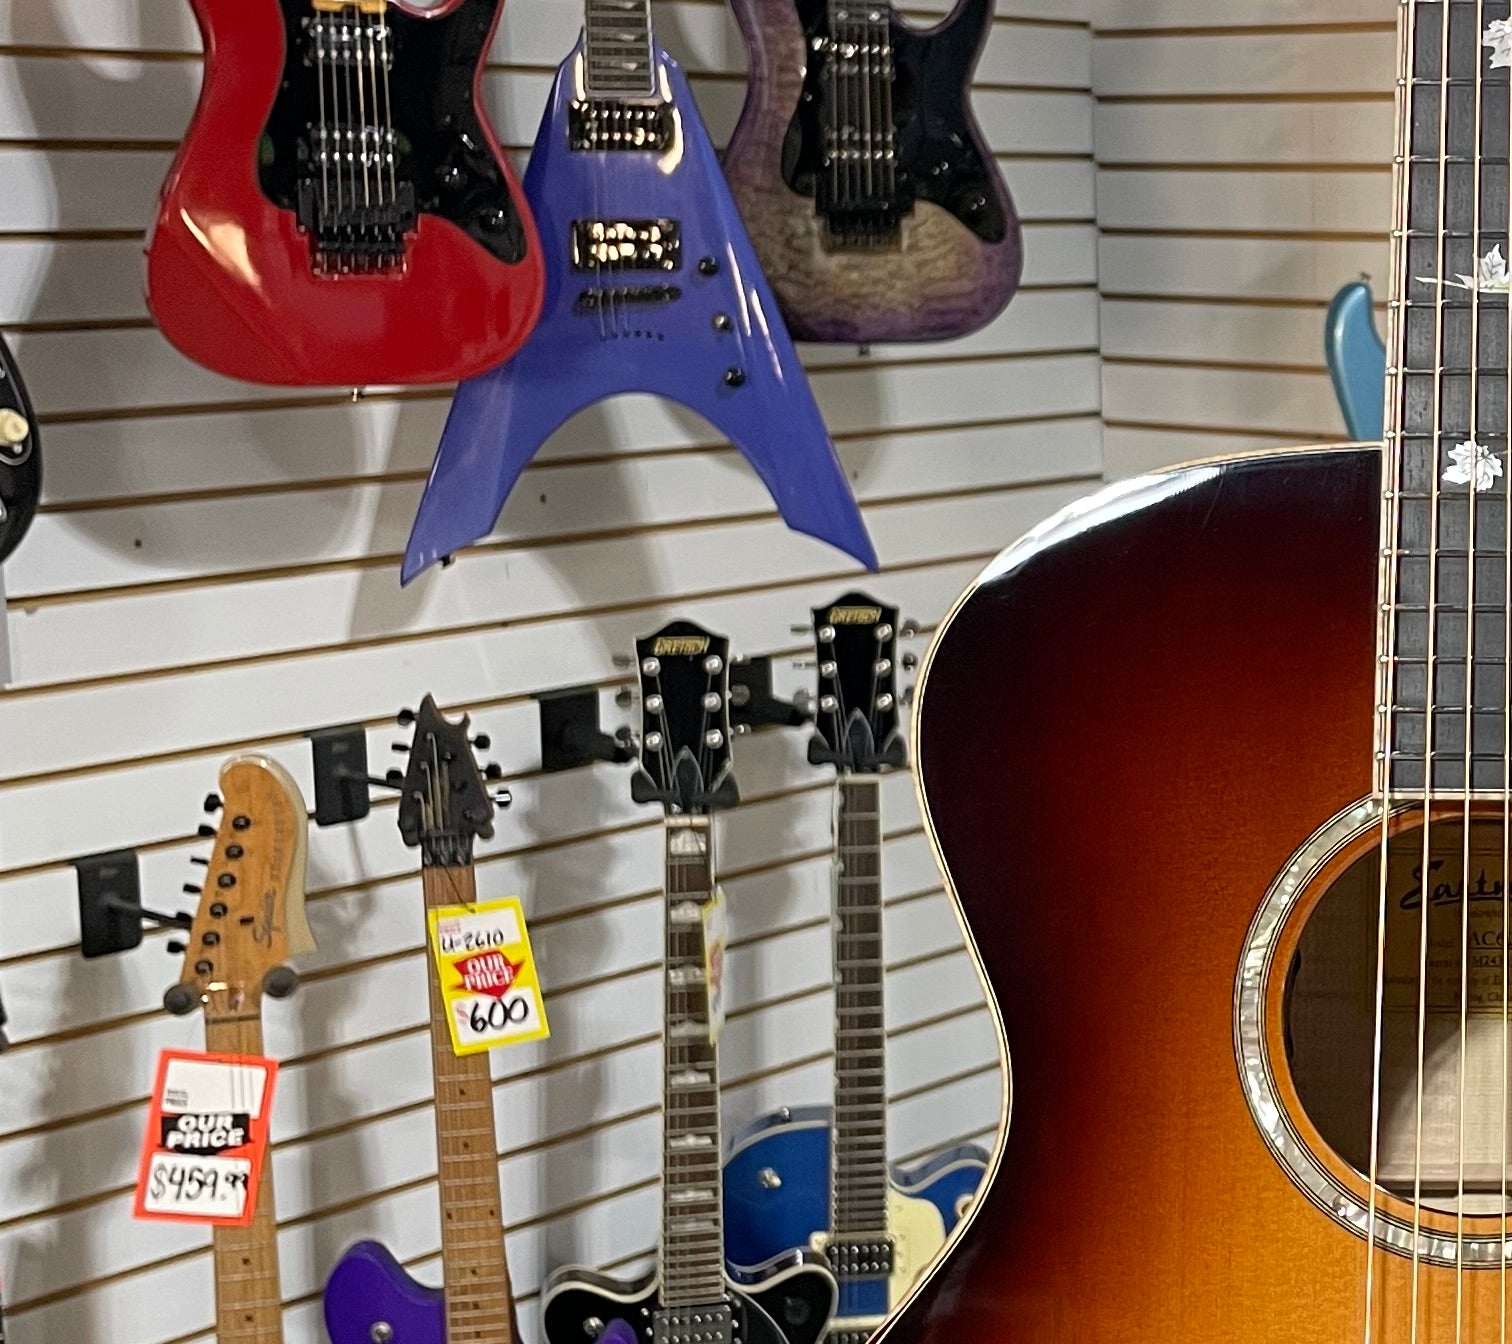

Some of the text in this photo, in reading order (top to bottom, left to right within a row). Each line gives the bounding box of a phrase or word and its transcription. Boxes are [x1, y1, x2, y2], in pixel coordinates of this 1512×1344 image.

[467, 954, 505, 976] OUR
[464, 966, 515, 991] PRICE
[456, 997, 529, 1033] $600
[177, 1113, 234, 1133] OUR
[165, 1127, 245, 1150] PRICE
